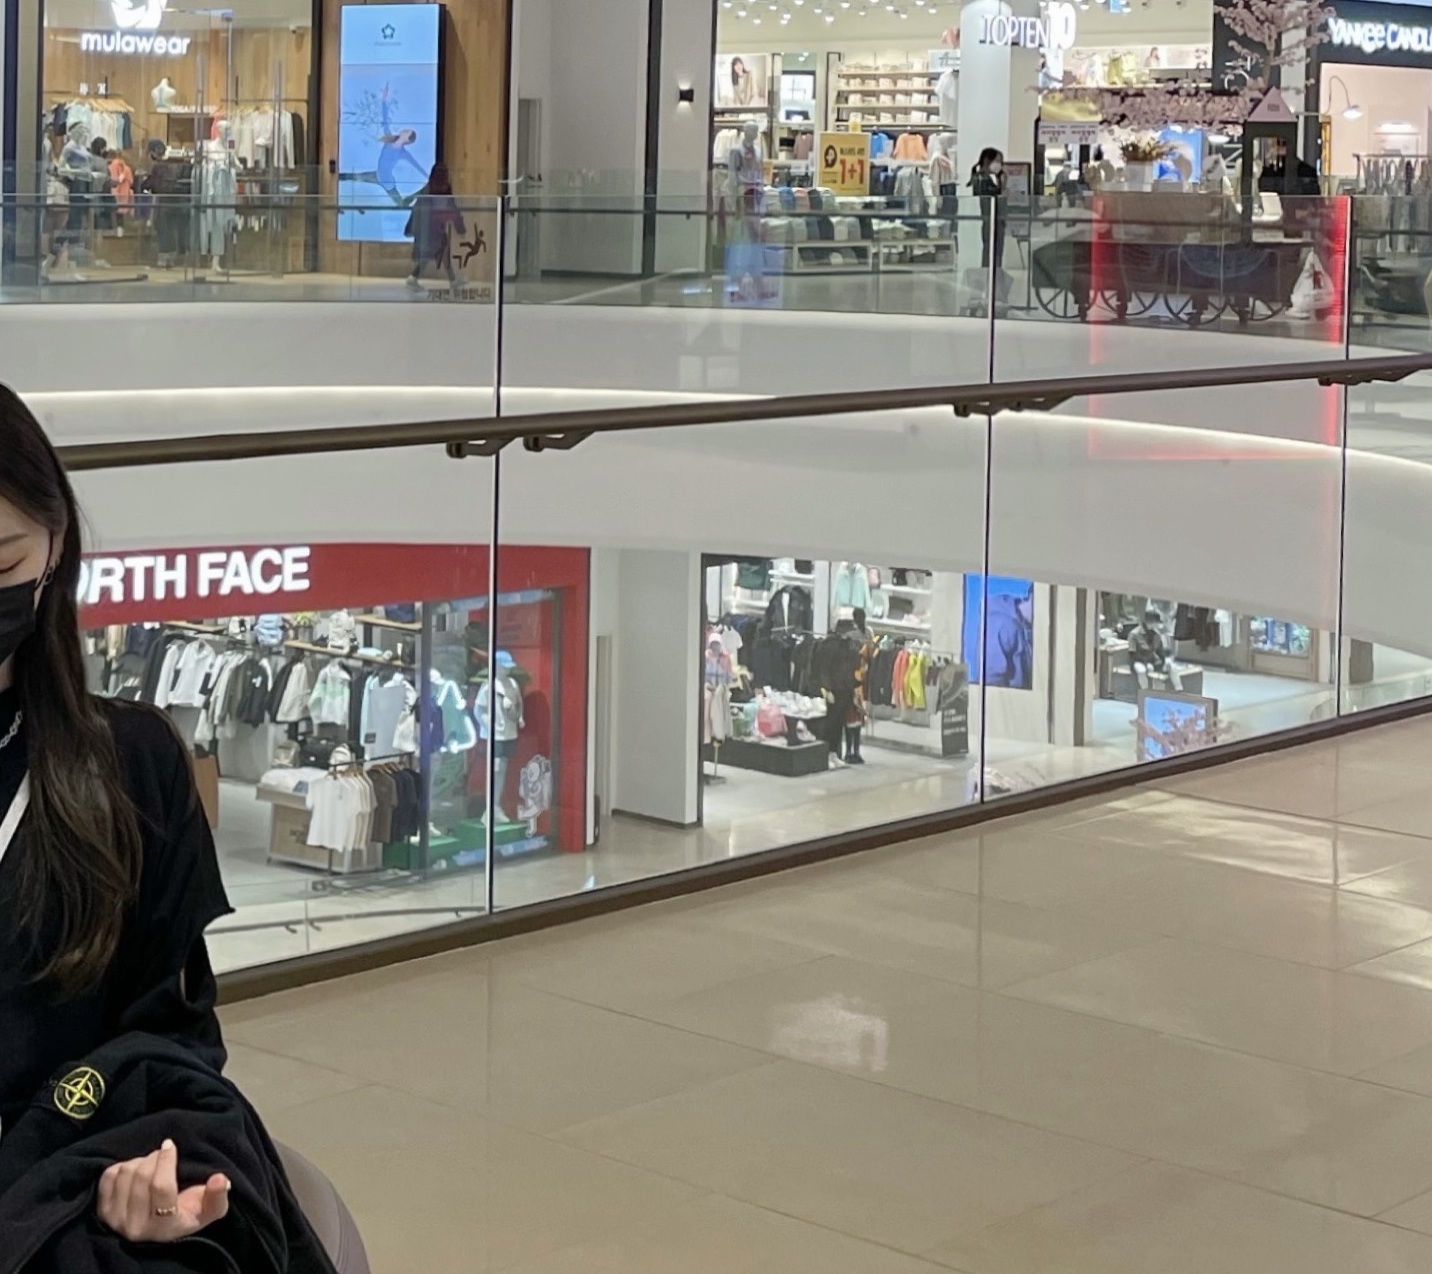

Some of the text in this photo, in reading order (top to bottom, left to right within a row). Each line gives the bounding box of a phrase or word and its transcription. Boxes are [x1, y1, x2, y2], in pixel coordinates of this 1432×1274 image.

[80, 30, 190, 55] mulawear
[1386, 22, 1432, 53] CANDL
[839, 158, 865, 185] 1+1
[76, 546, 310, 604] RTH FACE
